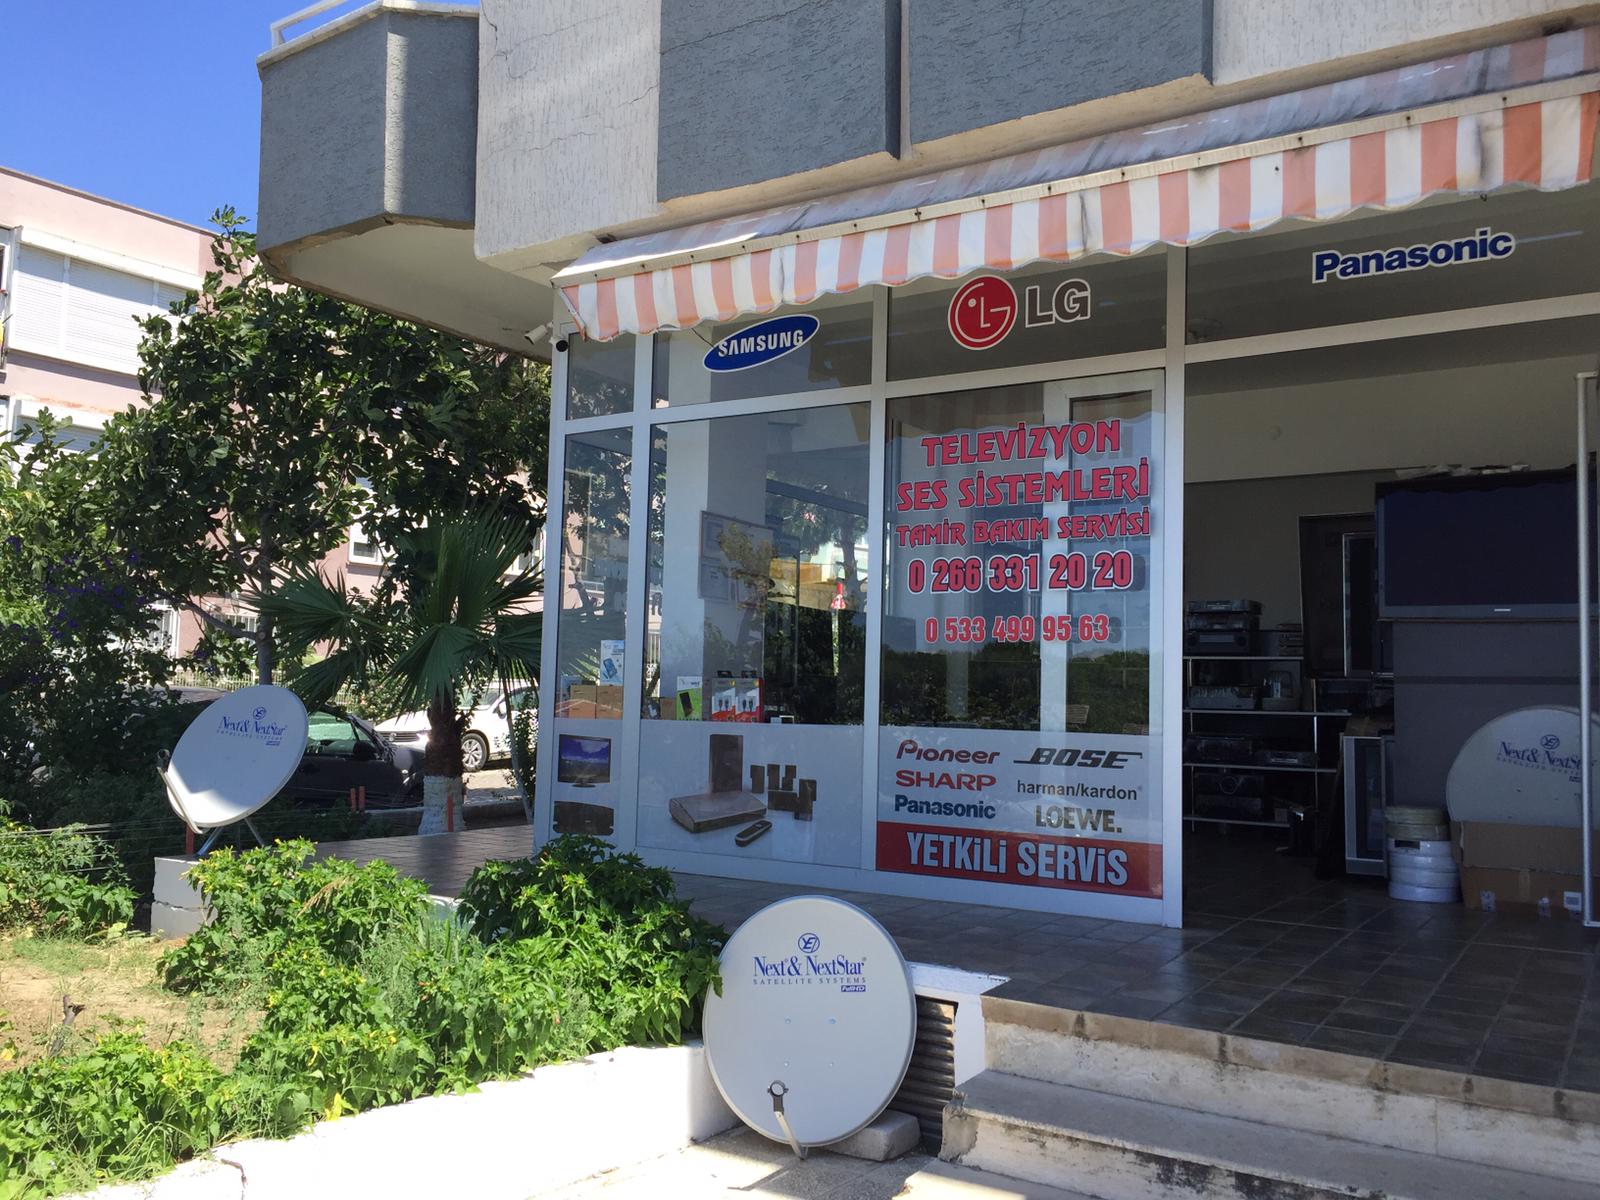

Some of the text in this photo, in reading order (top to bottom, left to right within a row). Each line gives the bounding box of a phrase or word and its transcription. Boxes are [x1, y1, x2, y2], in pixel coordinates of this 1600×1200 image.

[1312, 226, 1516, 284] Panasonic
[1025, 278, 1091, 328] LG
[718, 329, 804, 358] SAMSUNG
[921, 419, 1120, 467] TELEVİZYON
[896, 457, 1150, 512] SES SİSTEMLERİ
[896, 506, 1151, 548] TAMİR BAKIM SERVİSİ
[908, 549, 1134, 593] 0 266 331 20 20
[925, 613, 1110, 643] 0 533 499 95 63
[896, 739, 1000, 764] Pioneer
[1014, 747, 1142, 769] BOSE
[895, 769, 997, 791] SHARP
[1017, 780, 1137, 801] harman/kardon
[894, 794, 996, 819] Panasonic
